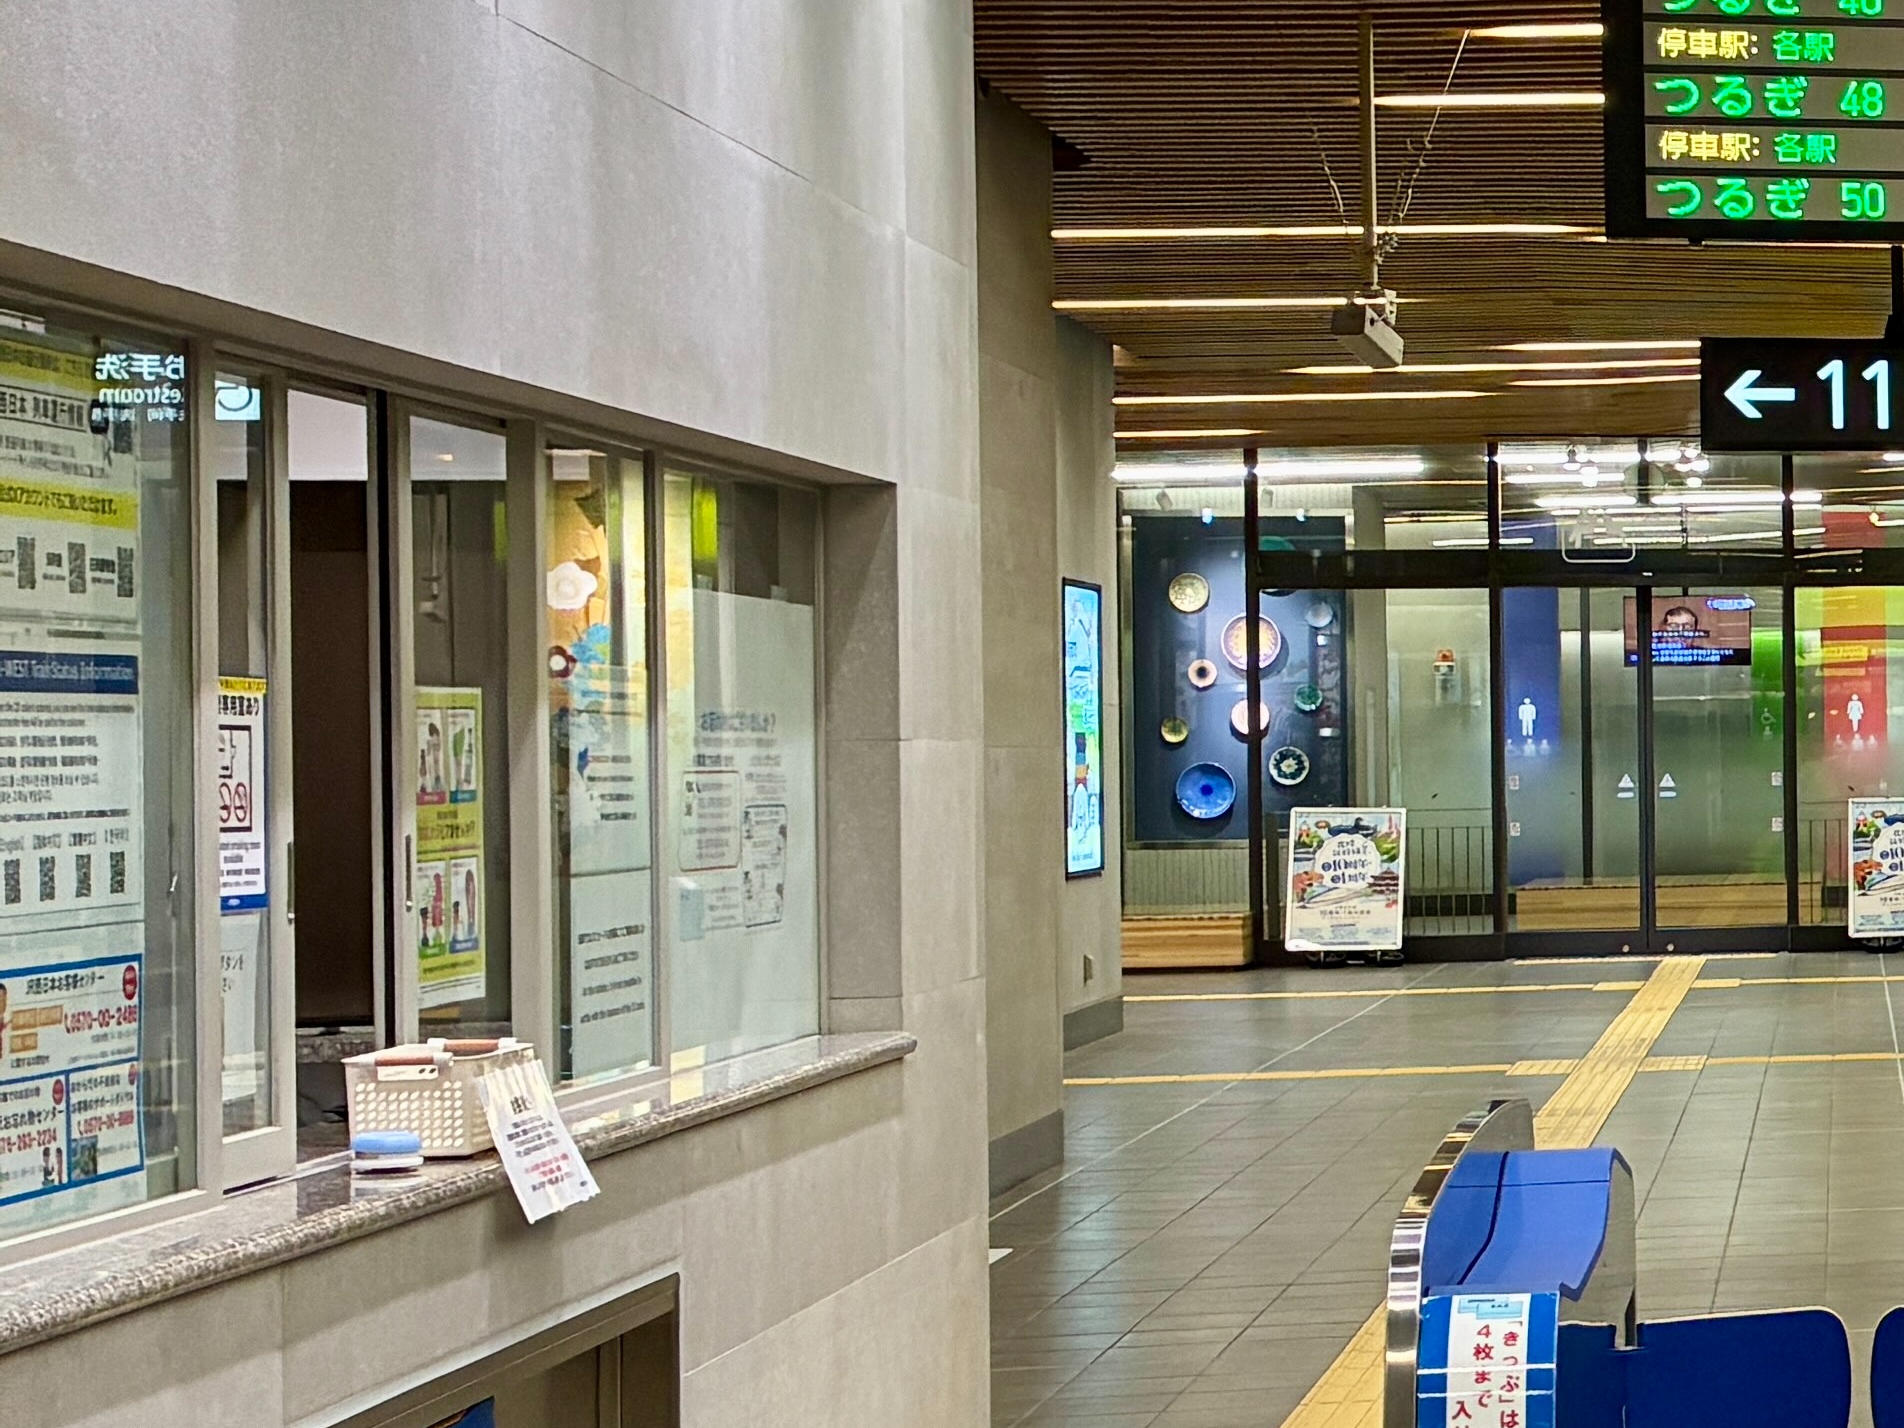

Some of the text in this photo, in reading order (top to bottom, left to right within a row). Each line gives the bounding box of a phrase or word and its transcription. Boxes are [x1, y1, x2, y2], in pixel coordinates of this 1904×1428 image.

[1772, 31, 1835, 62] 各駅
[1654, 77, 1808, 117] つるぎ
[1840, 80, 1883, 116] 48
[1774, 133, 1836, 164] 各駅
[1656, 178, 1810, 219] つるぎ
[1841, 183, 1885, 218] 50
[1817, 359, 1889, 430] 11
[1473, 1324, 1495, 1408] 4枚まで
